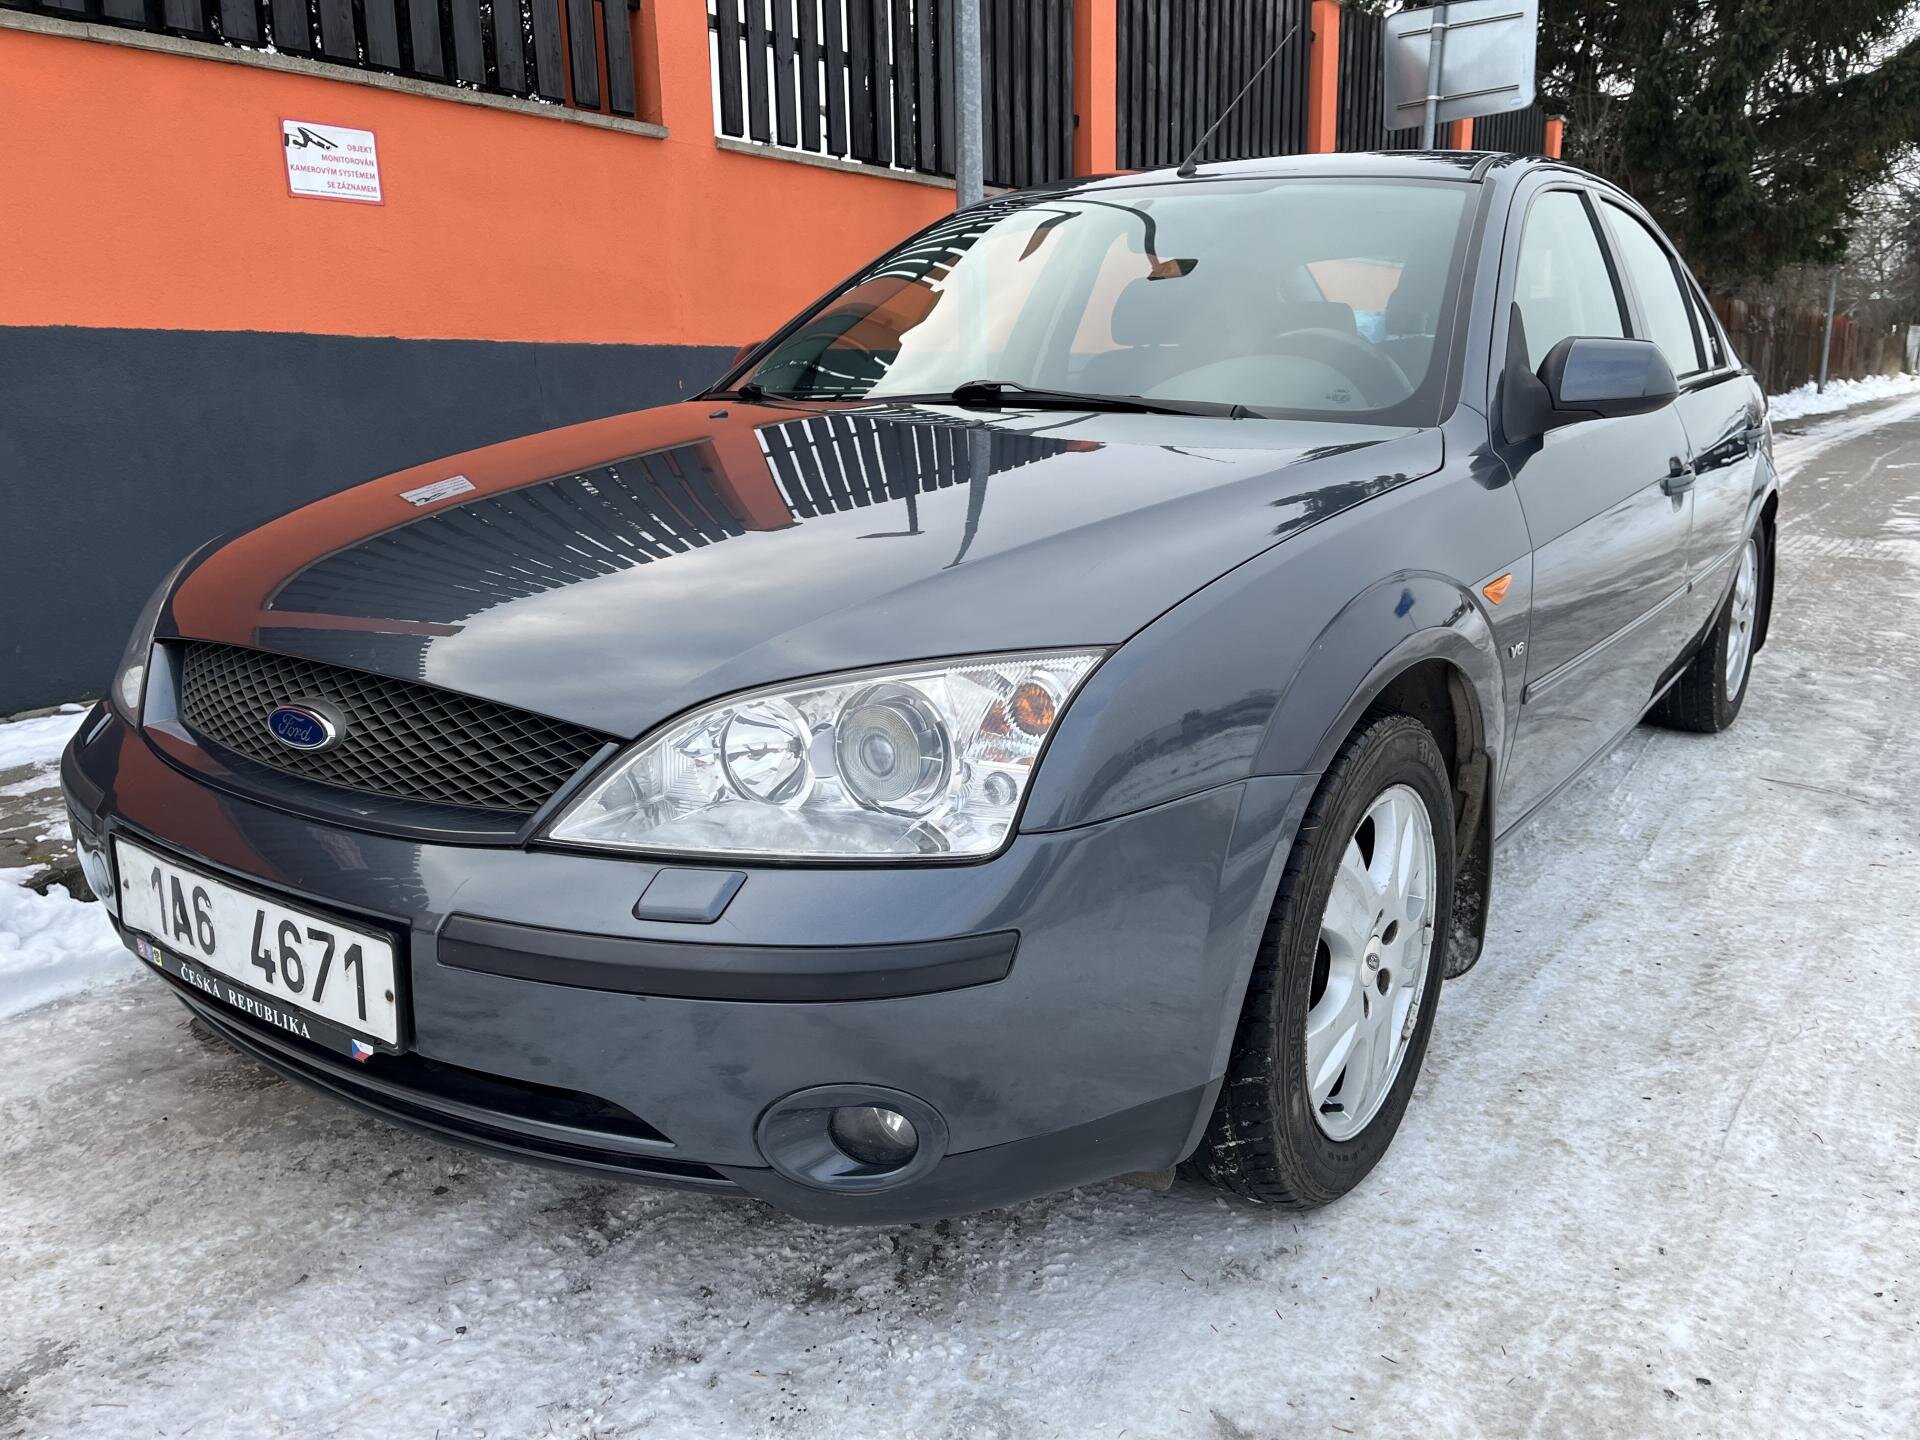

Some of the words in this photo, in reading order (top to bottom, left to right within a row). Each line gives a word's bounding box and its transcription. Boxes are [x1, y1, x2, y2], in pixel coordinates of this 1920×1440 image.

[346, 144, 373, 154] OBJEKT
[321, 154, 374, 167] MONITOROVÁN
[290, 164, 338, 176] KAMEROVÝM
[338, 169, 376, 180] SYSTÉMEM
[327, 181, 336, 189] SE
[337, 181, 377, 193] ZÁZNAMEM
[1510, 641, 1525, 658] V6
[278, 713, 313, 742] Ford
[150, 866, 216, 956] 1A6
[250, 909, 368, 1022] 4671
[180, 962, 222, 999] ČESKÁ
[227, 988, 312, 1040] REPUBLIKA
